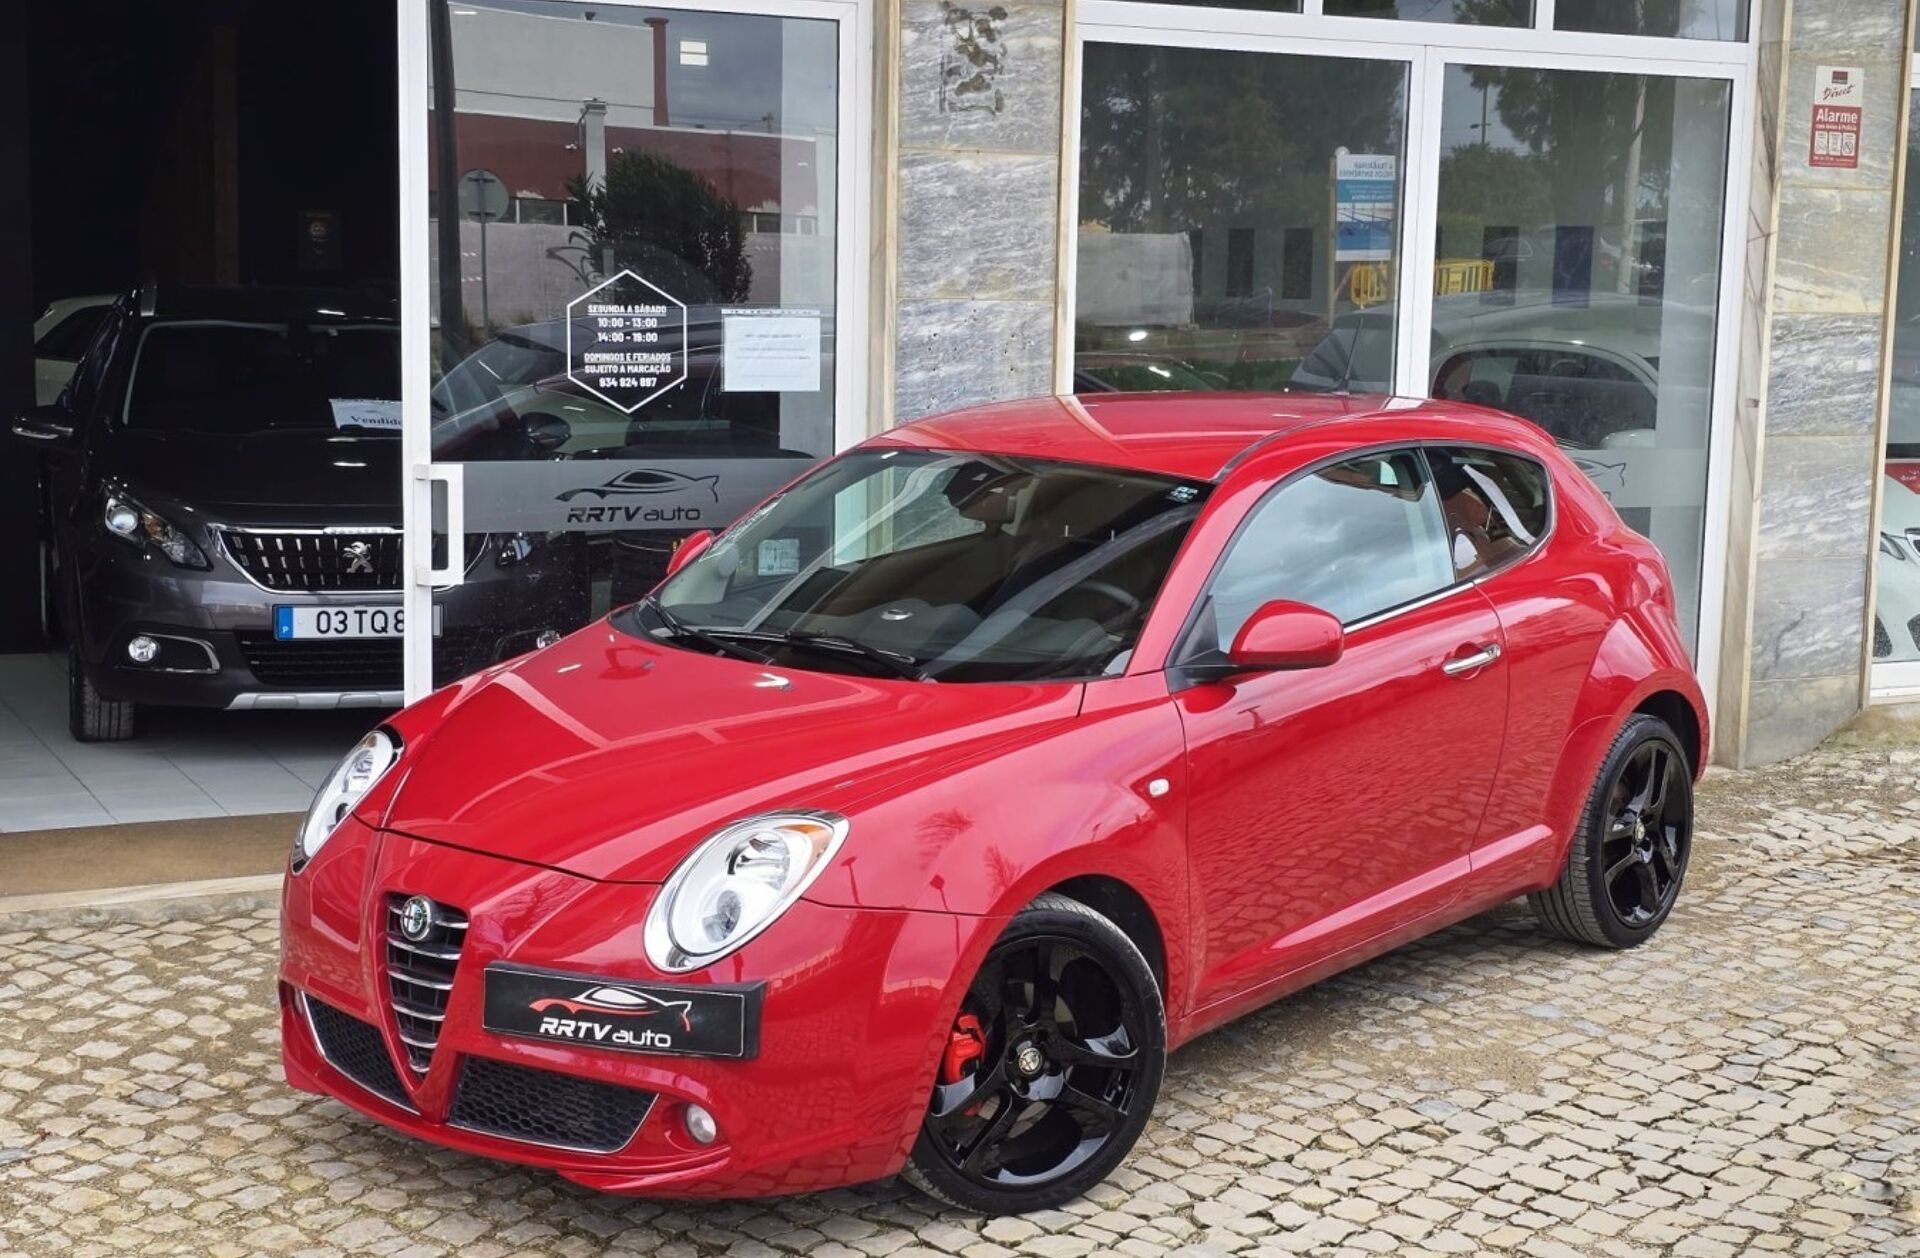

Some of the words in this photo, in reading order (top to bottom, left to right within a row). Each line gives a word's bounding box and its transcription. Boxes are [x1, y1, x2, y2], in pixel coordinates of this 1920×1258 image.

[1816, 108, 1858, 124] Alarme
[587, 304, 625, 313] SEGUNDA
[627, 304, 633, 313] A
[634, 303, 667, 313] SÁBADO
[598, 318, 624, 328] 10:00
[632, 318, 658, 328] 13:00
[597, 332, 624, 342] 14:00
[584, 353, 625, 362] DOMINGOS
[626, 353, 632, 362] E
[632, 353, 671, 362] FERIADOS
[584, 365, 618, 373] SUJEITO
[620, 365, 627, 373] A
[627, 363, 671, 375] MARCAÇÃO
[351, 415, 402, 426] Vendid
[567, 506, 643, 523] RRTV
[643, 506, 701, 522] auto
[316, 609, 404, 635] 03TQ8
[539, 1017, 613, 1041] RRTV
[612, 1029, 672, 1047] auto
